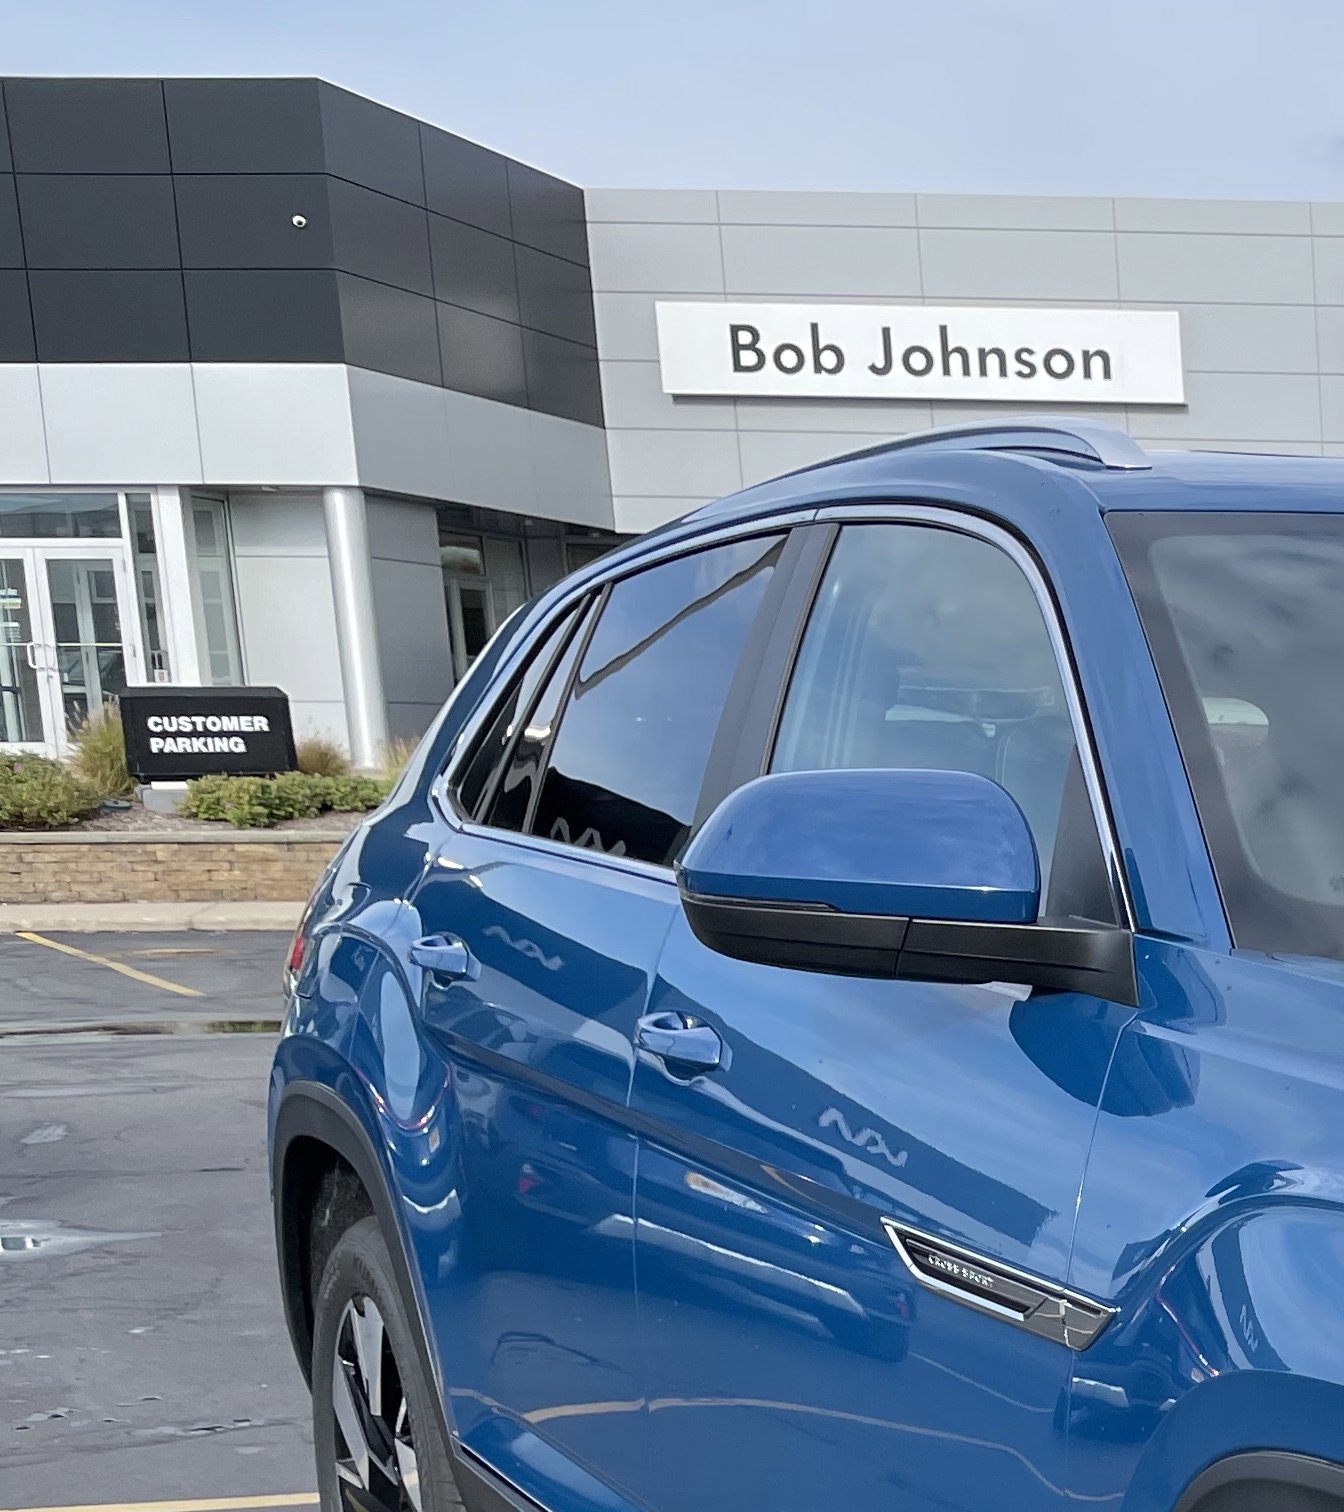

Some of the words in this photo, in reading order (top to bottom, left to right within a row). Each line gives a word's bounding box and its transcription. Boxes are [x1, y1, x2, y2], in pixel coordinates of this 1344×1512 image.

[729, 322, 846, 375] Bob
[867, 324, 1113, 381] Johnson
[146, 715, 271, 733] CUSTOMER
[149, 736, 248, 754] PARKING
